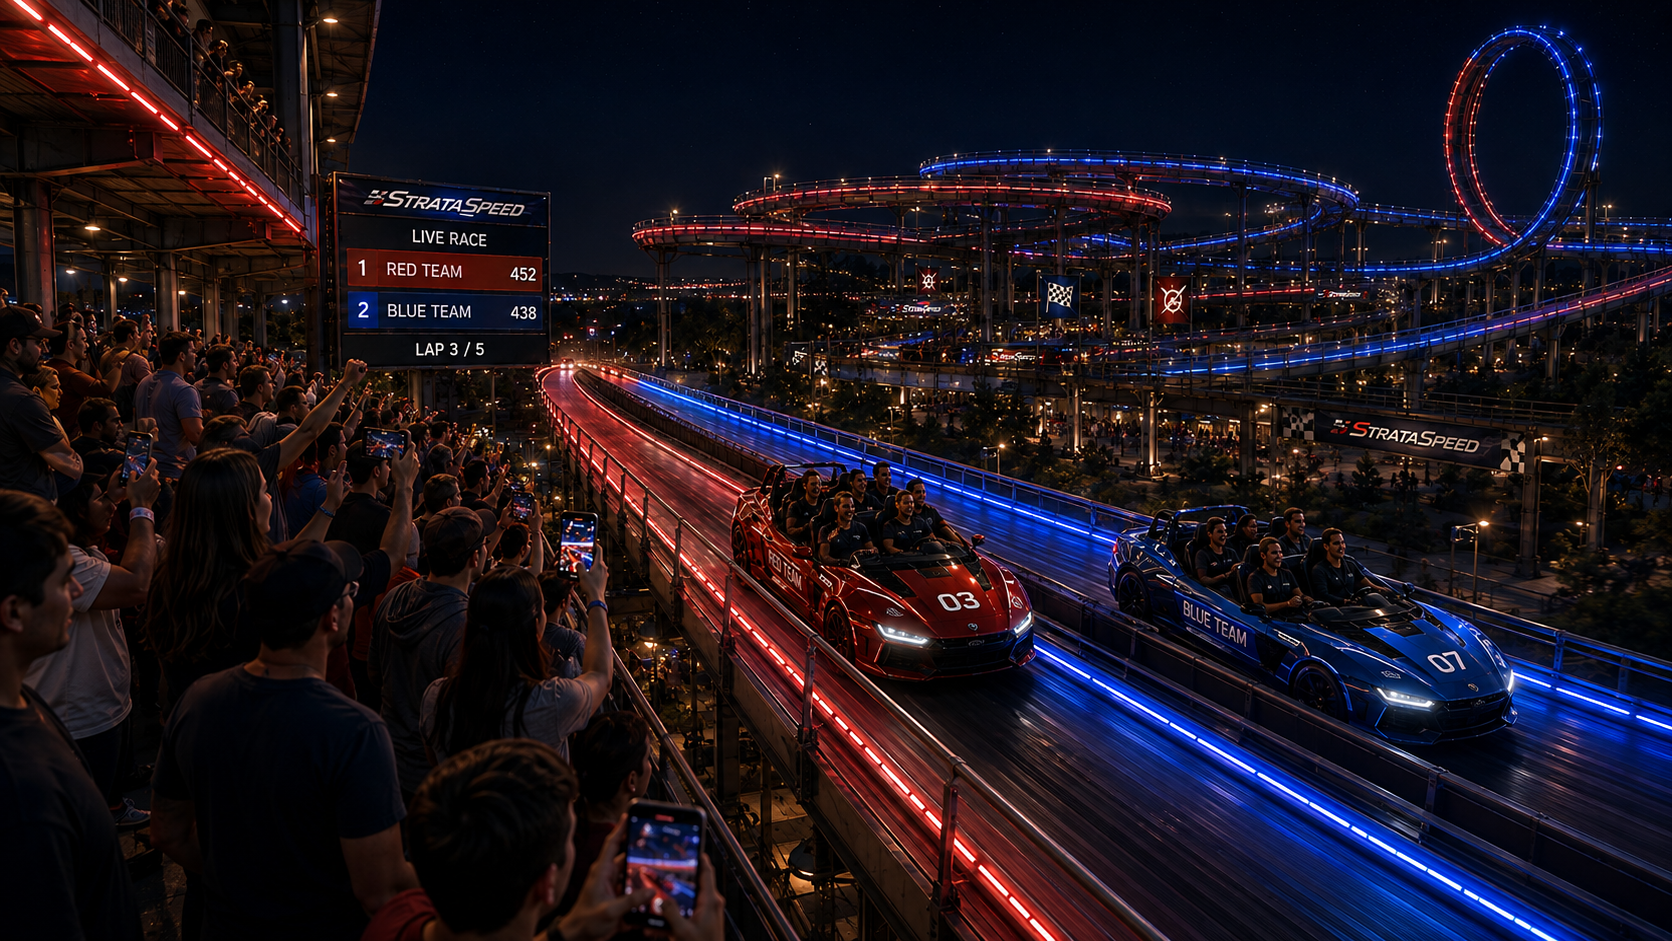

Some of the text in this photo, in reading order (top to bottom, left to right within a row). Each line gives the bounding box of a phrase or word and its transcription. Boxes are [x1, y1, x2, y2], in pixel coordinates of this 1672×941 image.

[412, 229, 487, 247] LIVE RACE
[358, 259, 537, 282] 1 RED TEAM 452
[358, 302, 537, 320] 2 BLUE TEAM 438
[415, 342, 484, 357] LAP 3 / 5
[1349, 421, 1480, 453] STRATASPEED
[783, 561, 802, 591] TEAM
[937, 591, 981, 611] 03
[1183, 600, 1247, 648] BLUE TEAM
[1426, 650, 1468, 674] 07
